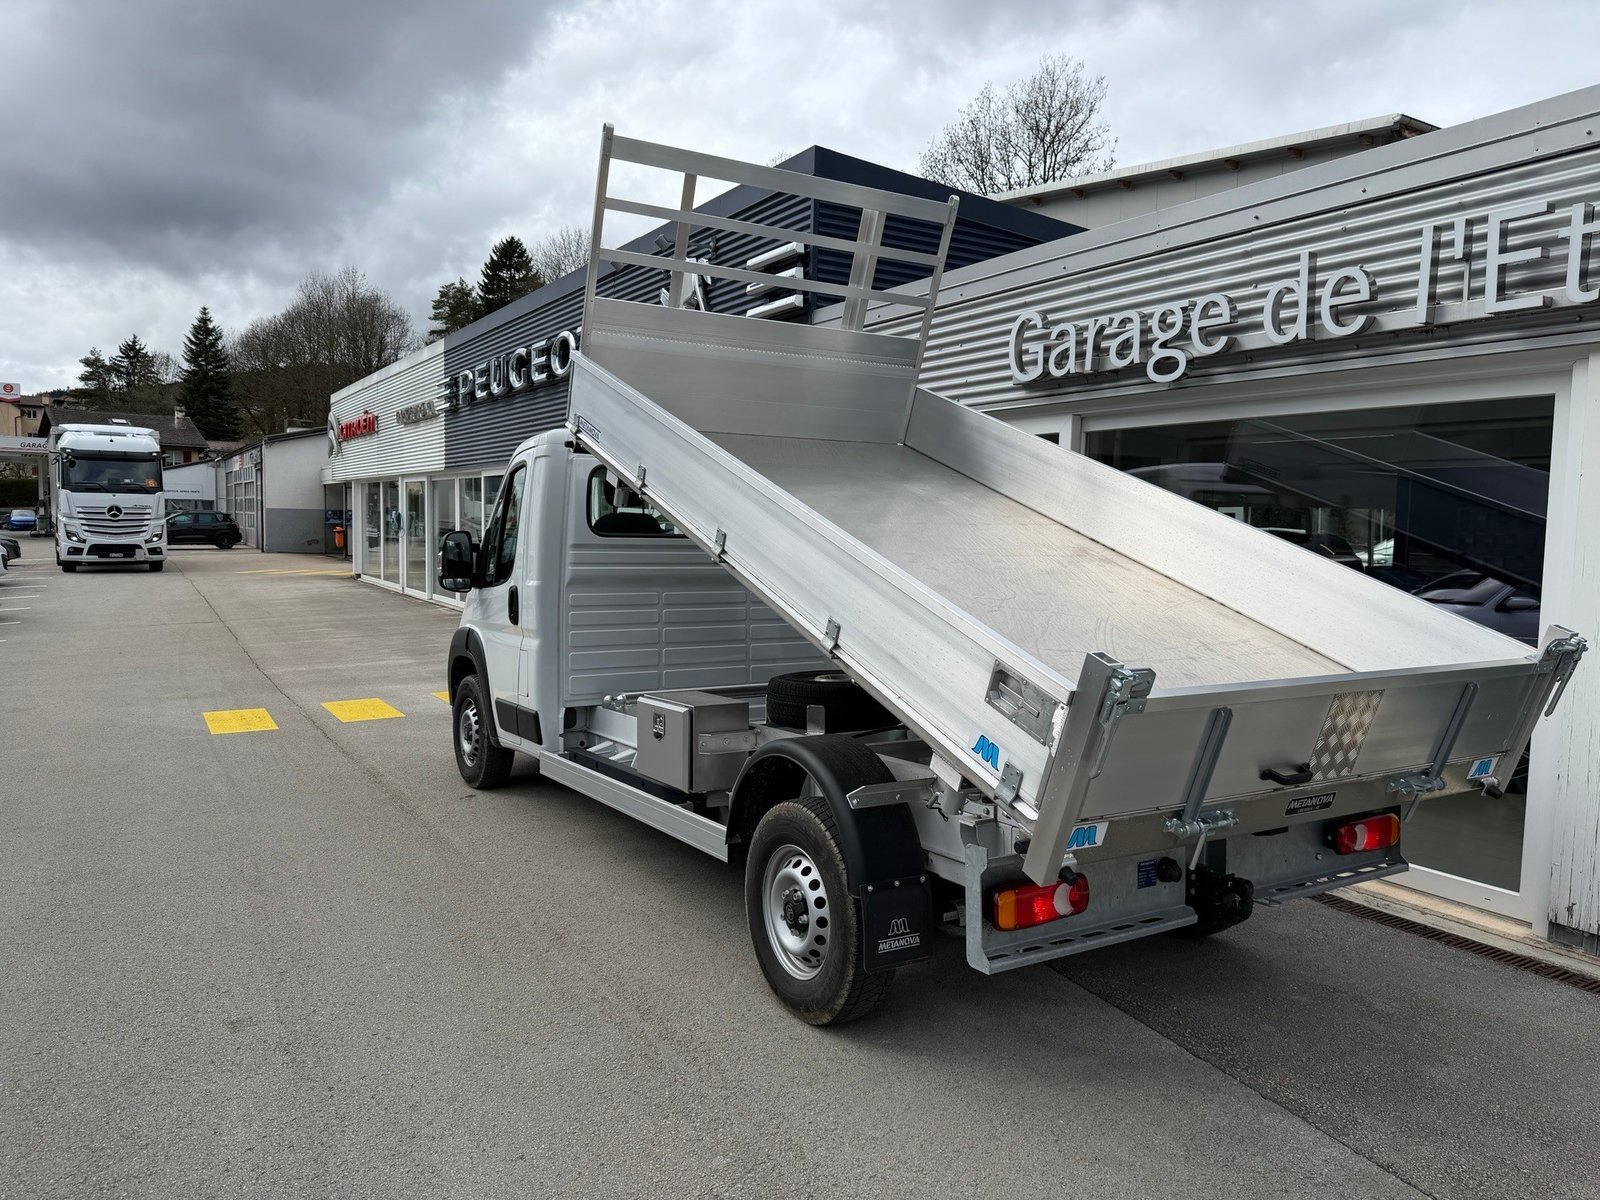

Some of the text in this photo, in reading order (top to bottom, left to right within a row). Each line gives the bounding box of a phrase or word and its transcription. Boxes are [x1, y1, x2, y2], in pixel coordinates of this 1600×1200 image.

[1008, 293, 1239, 384] Garage
[1262, 251, 1378, 345] de
[459, 327, 582, 405] PEUGEO
[20, 441, 48, 449] GARAG
[1288, 794, 1334, 810] METANOVA
[878, 935, 920, 951] METANOVA
